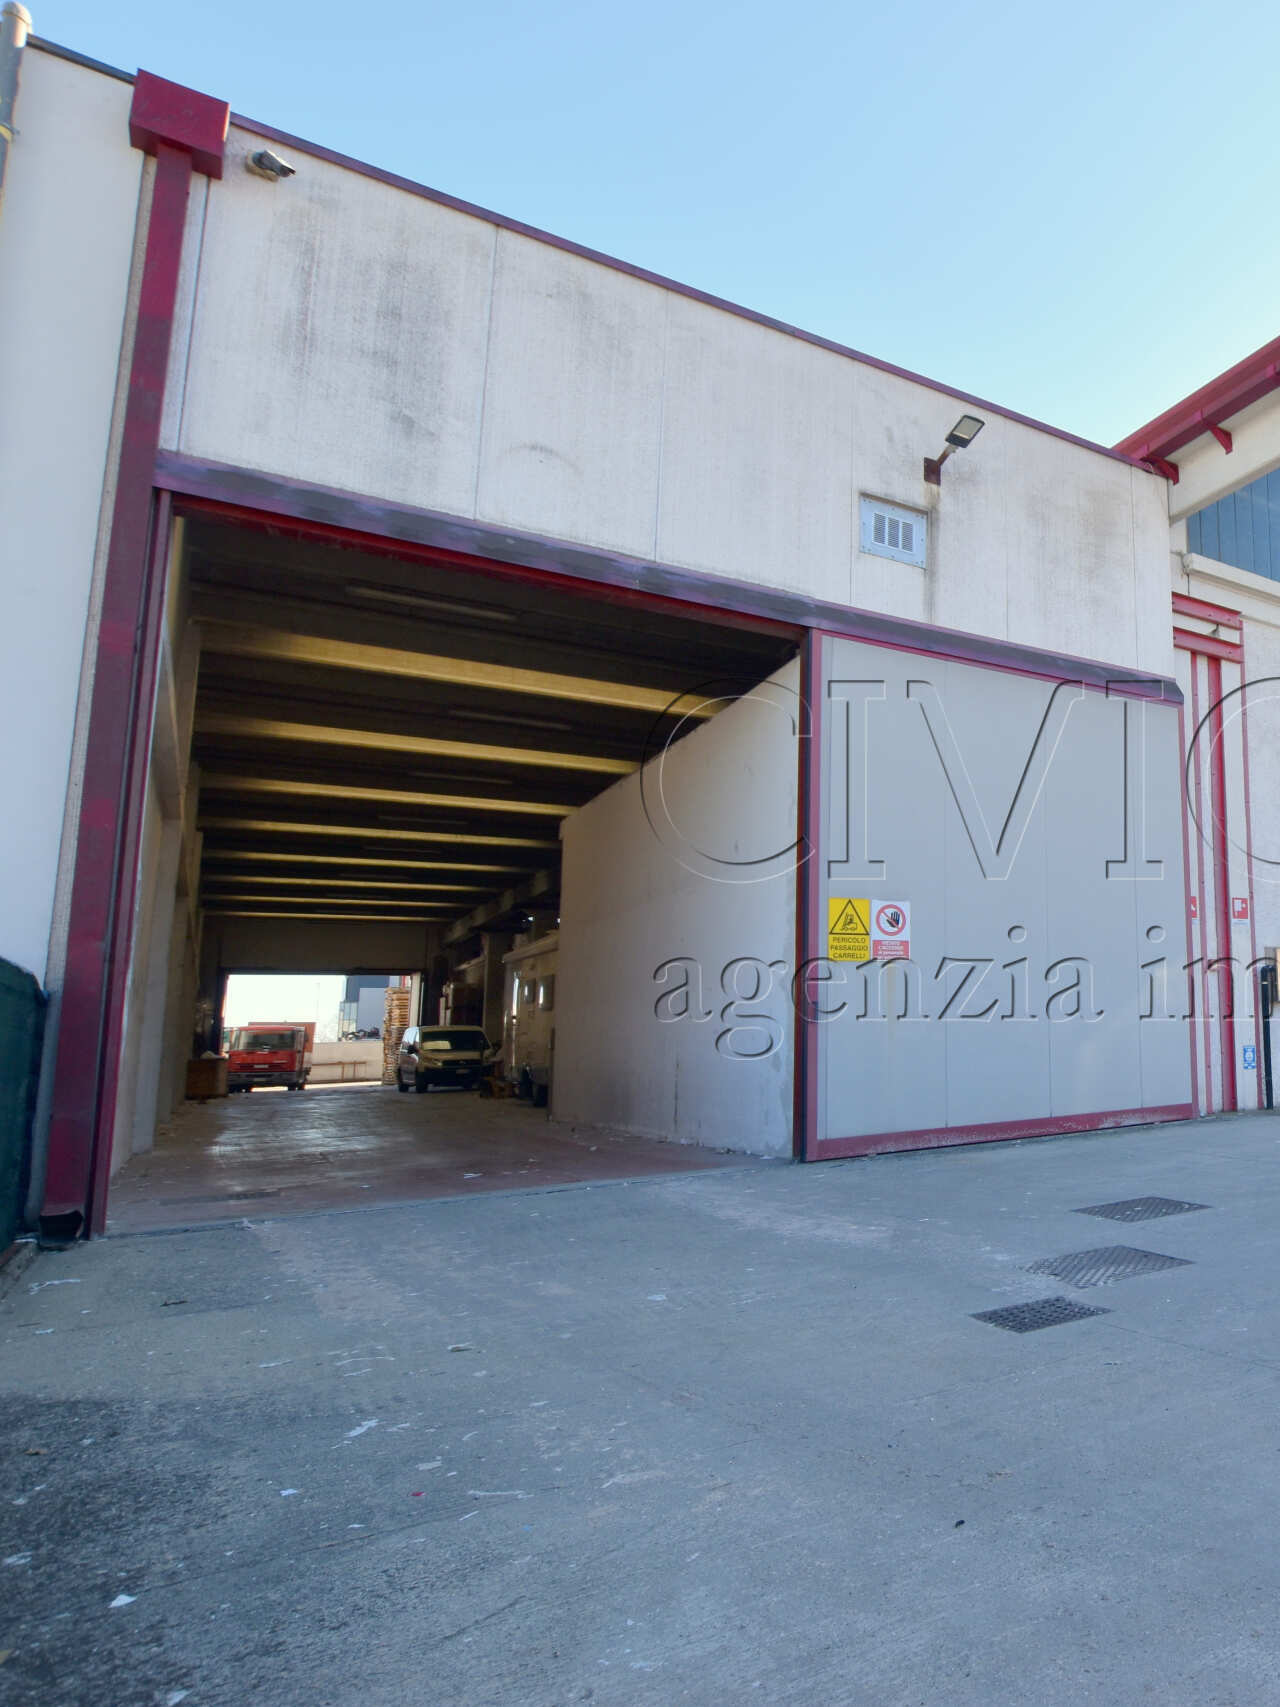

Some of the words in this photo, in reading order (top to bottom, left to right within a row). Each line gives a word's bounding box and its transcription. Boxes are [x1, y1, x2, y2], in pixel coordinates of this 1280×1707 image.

[832, 936, 866, 944] PERICOLO
[830, 944, 869, 952] PASSAGGIO
[832, 952, 866, 960] CARRELLI
